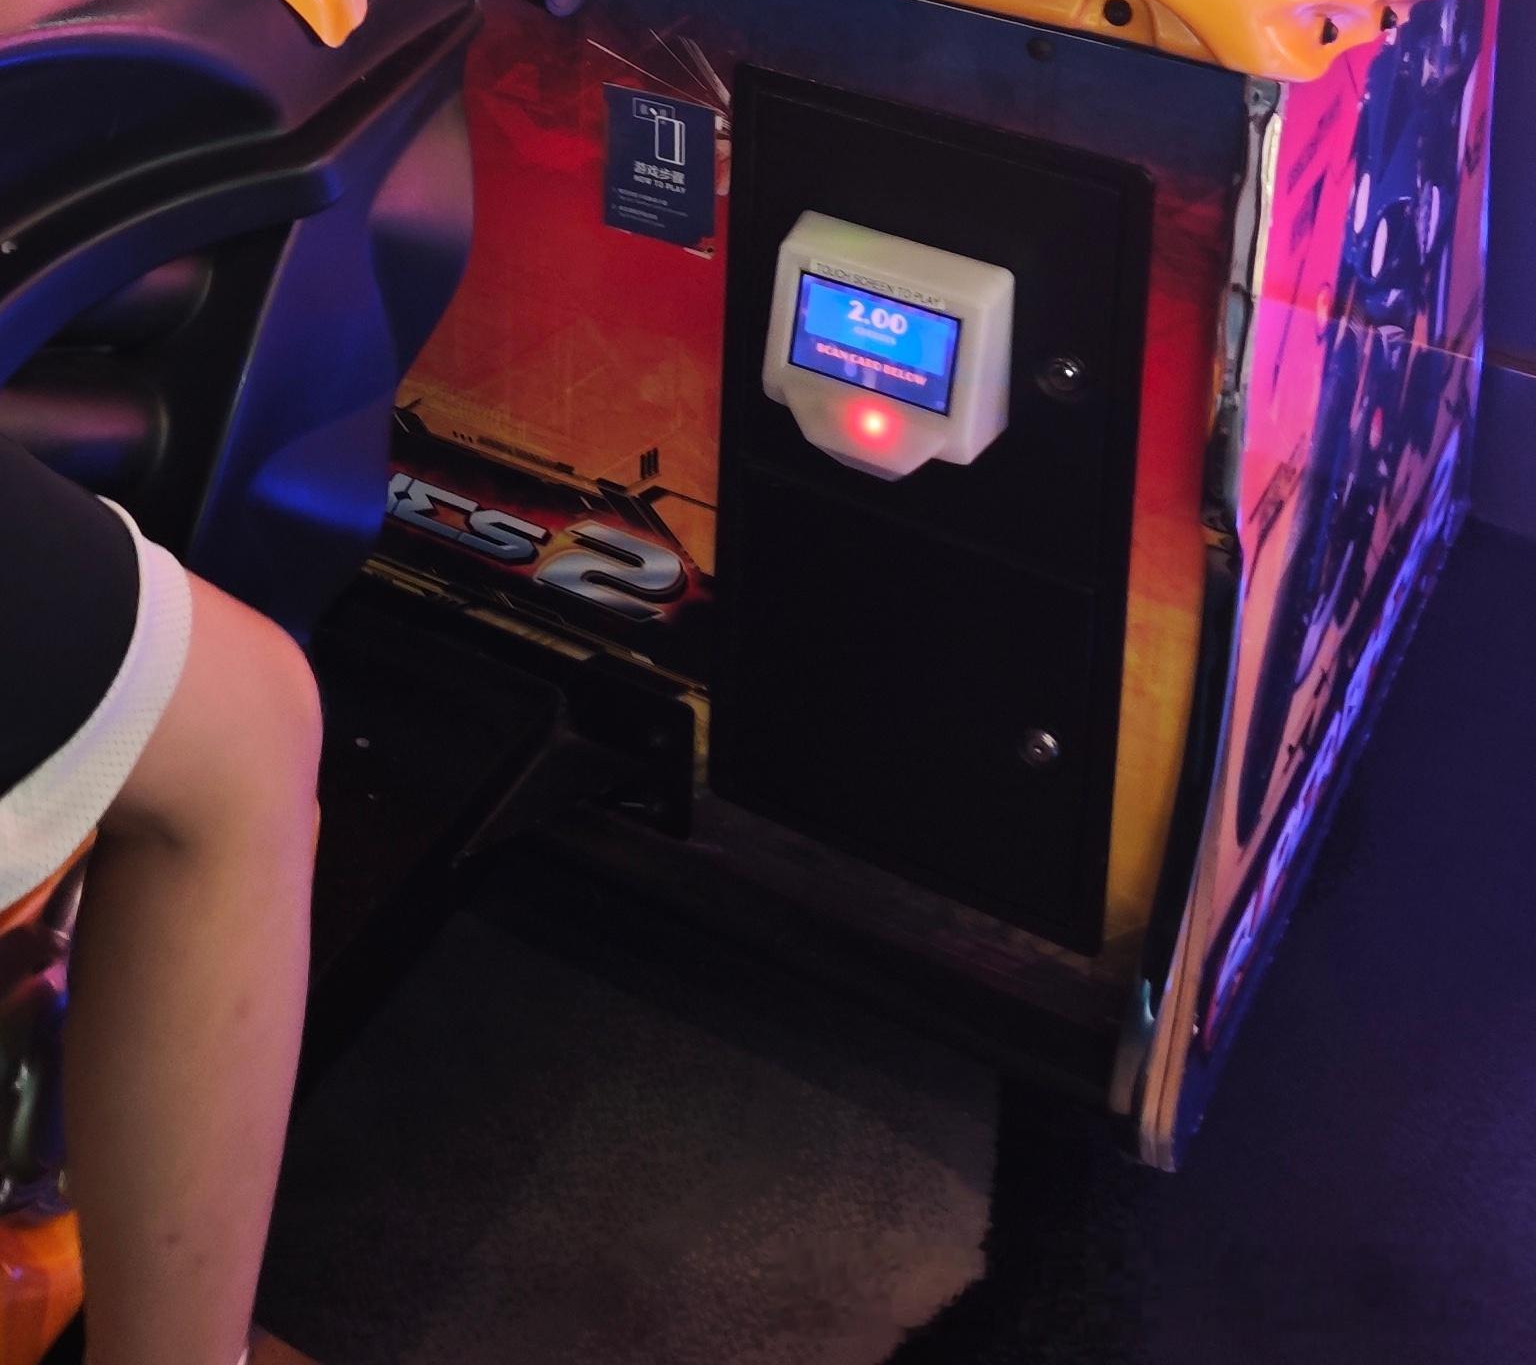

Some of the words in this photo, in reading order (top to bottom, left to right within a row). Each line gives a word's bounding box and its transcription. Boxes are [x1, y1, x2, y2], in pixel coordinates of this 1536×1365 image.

[816, 262, 850, 281] TOUCH
[855, 274, 894, 293] SCREEN
[898, 286, 912, 299] TO
[914, 292, 940, 307] PLAY
[847, 299, 908, 335] 2.00
[883, 363, 927, 386] BELOW
[534, 519, 687, 621] 2
